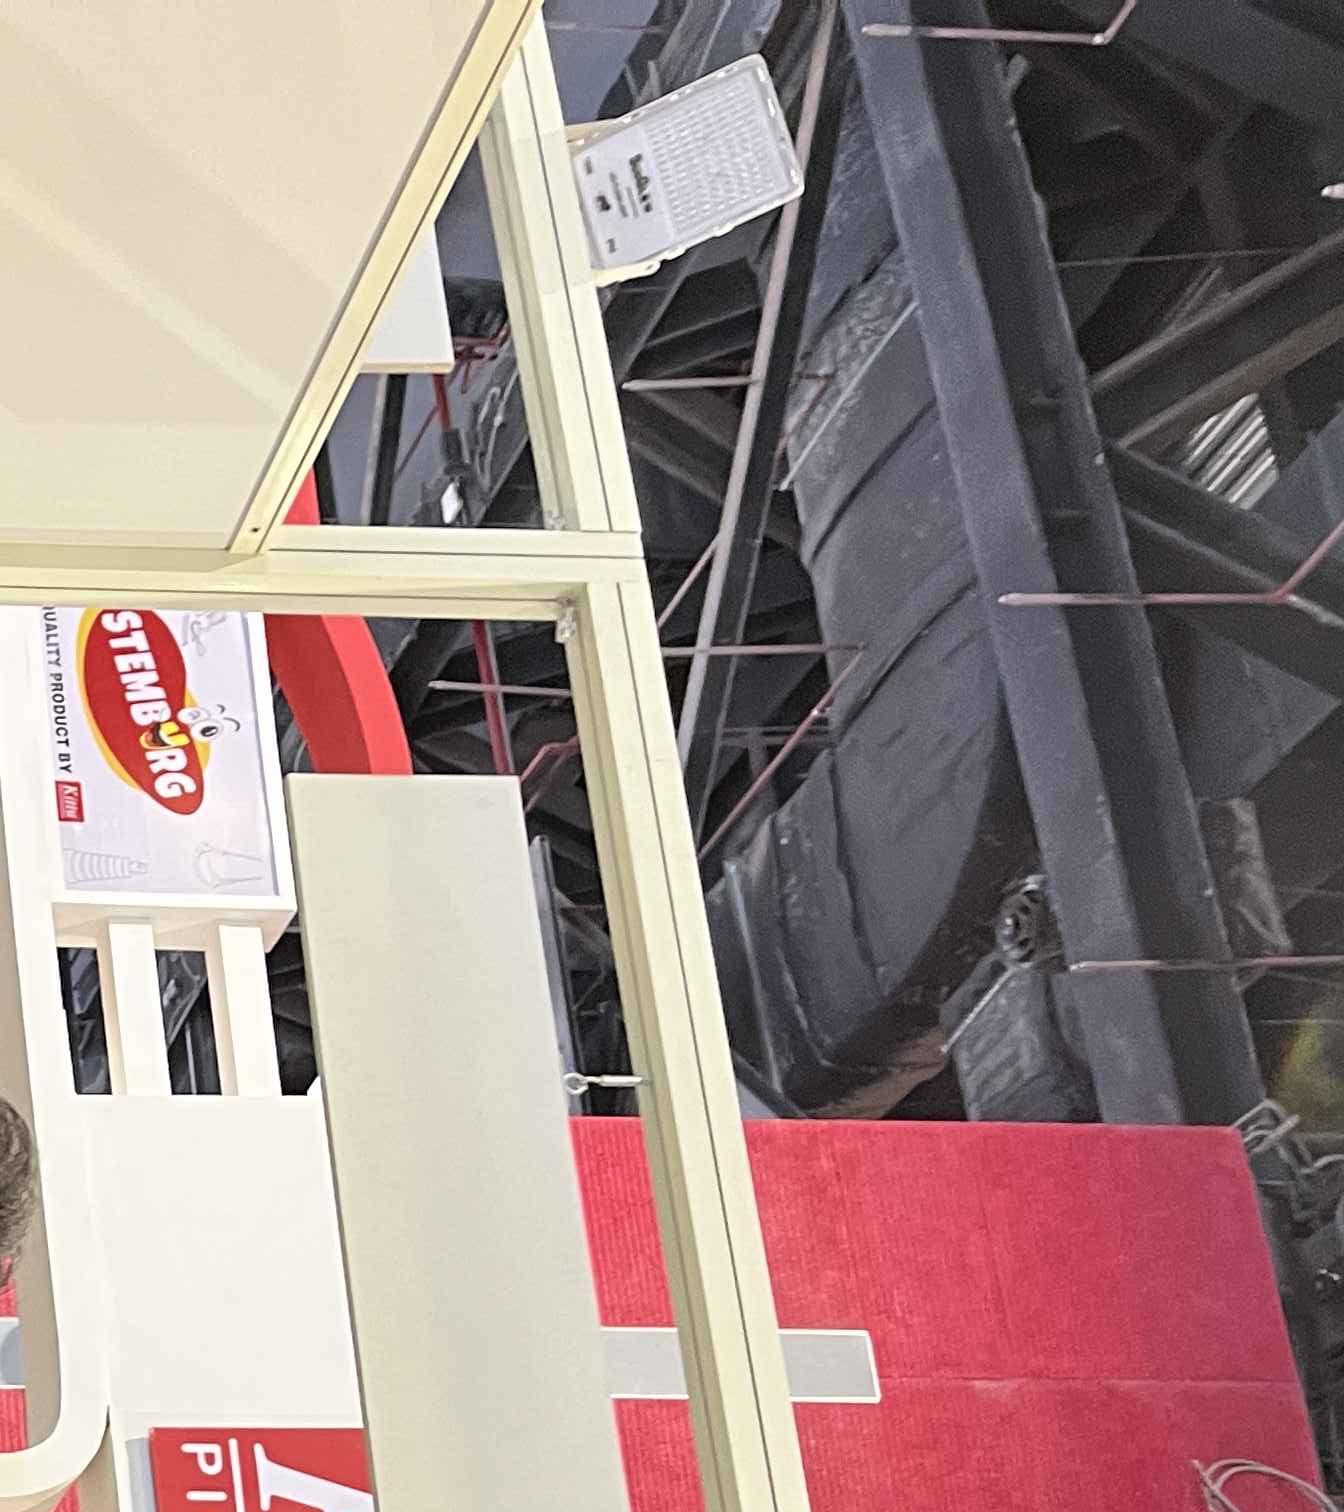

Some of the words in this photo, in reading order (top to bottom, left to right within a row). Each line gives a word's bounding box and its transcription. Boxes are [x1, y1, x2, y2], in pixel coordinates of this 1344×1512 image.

[49, 673, 69, 747] PRODUCT
[101, 611, 197, 798] STEMBURG
[58, 753, 72, 774] BY
